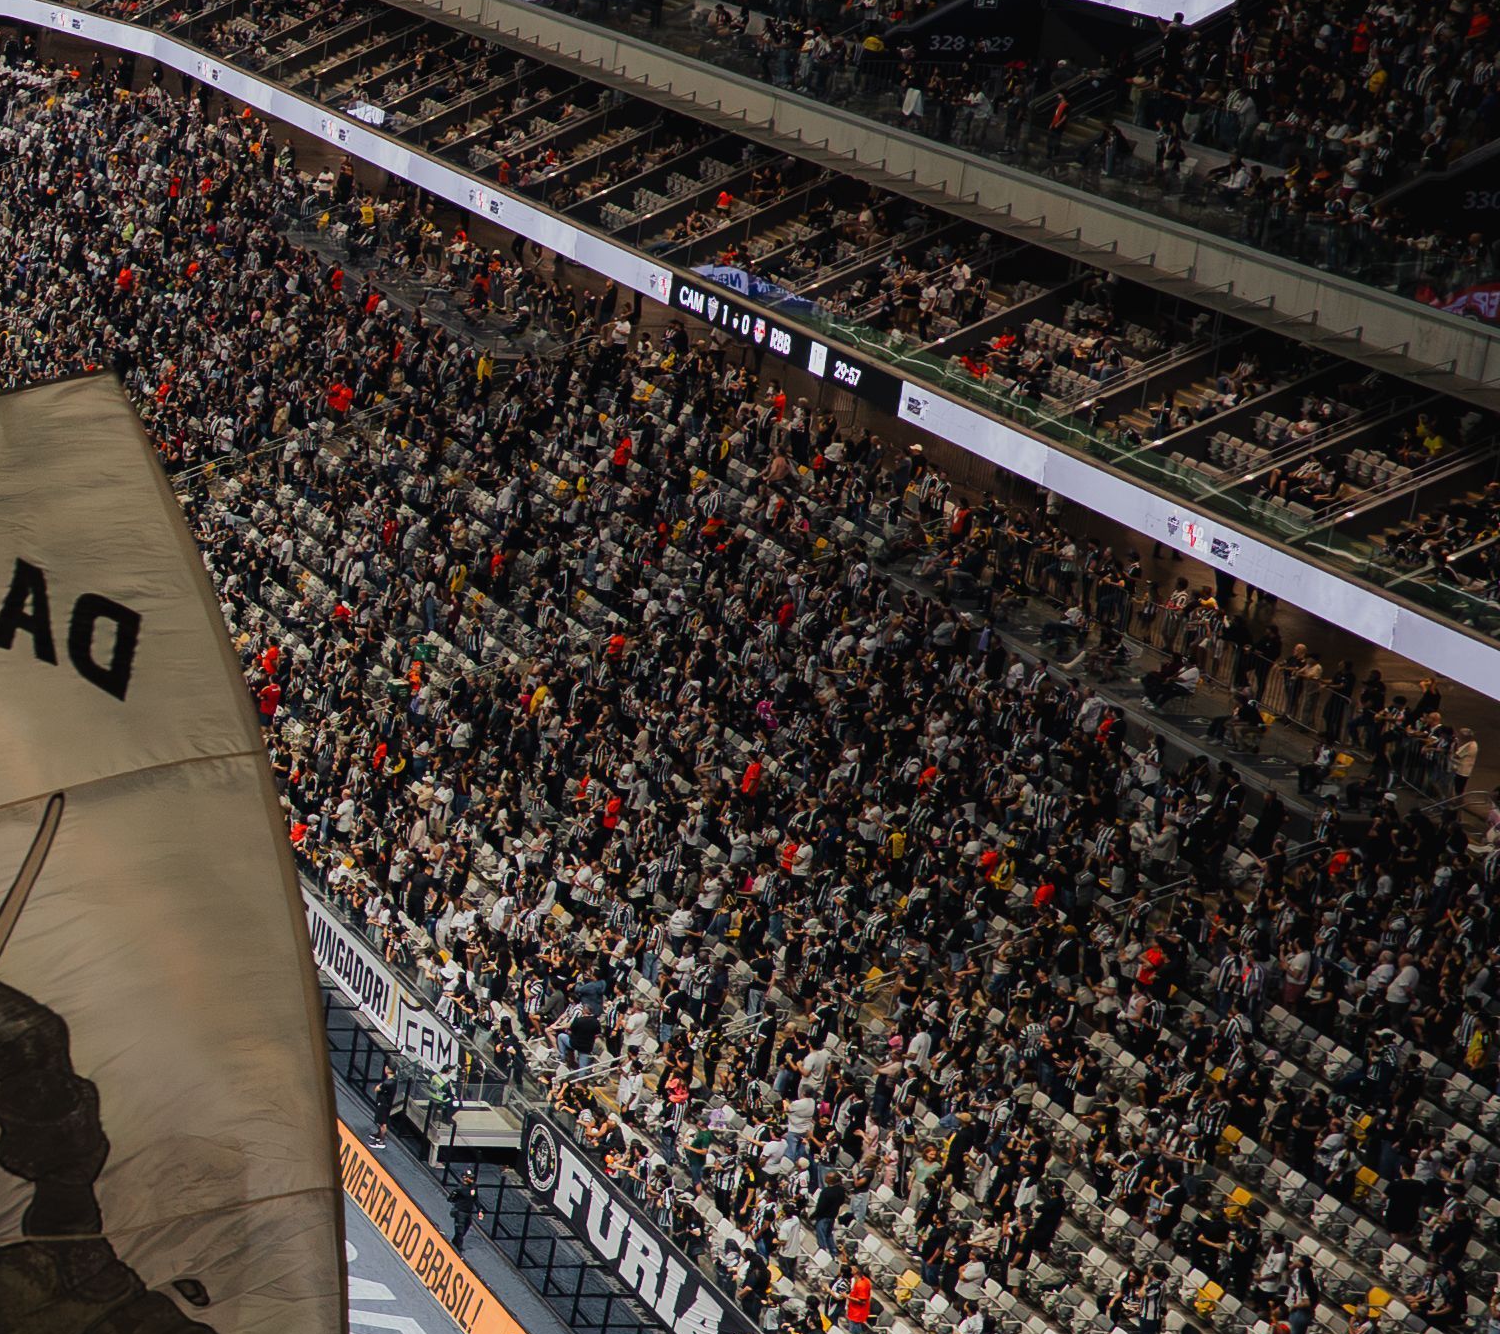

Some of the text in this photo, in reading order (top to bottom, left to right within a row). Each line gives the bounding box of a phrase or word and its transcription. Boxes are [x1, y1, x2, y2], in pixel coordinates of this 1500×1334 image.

[929, 35, 963, 51] 328
[679, 285, 791, 356] CAM 1 0 RBB
[833, 359, 862, 387] 29:57
[405, 1019, 454, 1066] CAM
[392, 1214, 423, 1263] DO
[415, 1235, 484, 1334] BRASIL!
